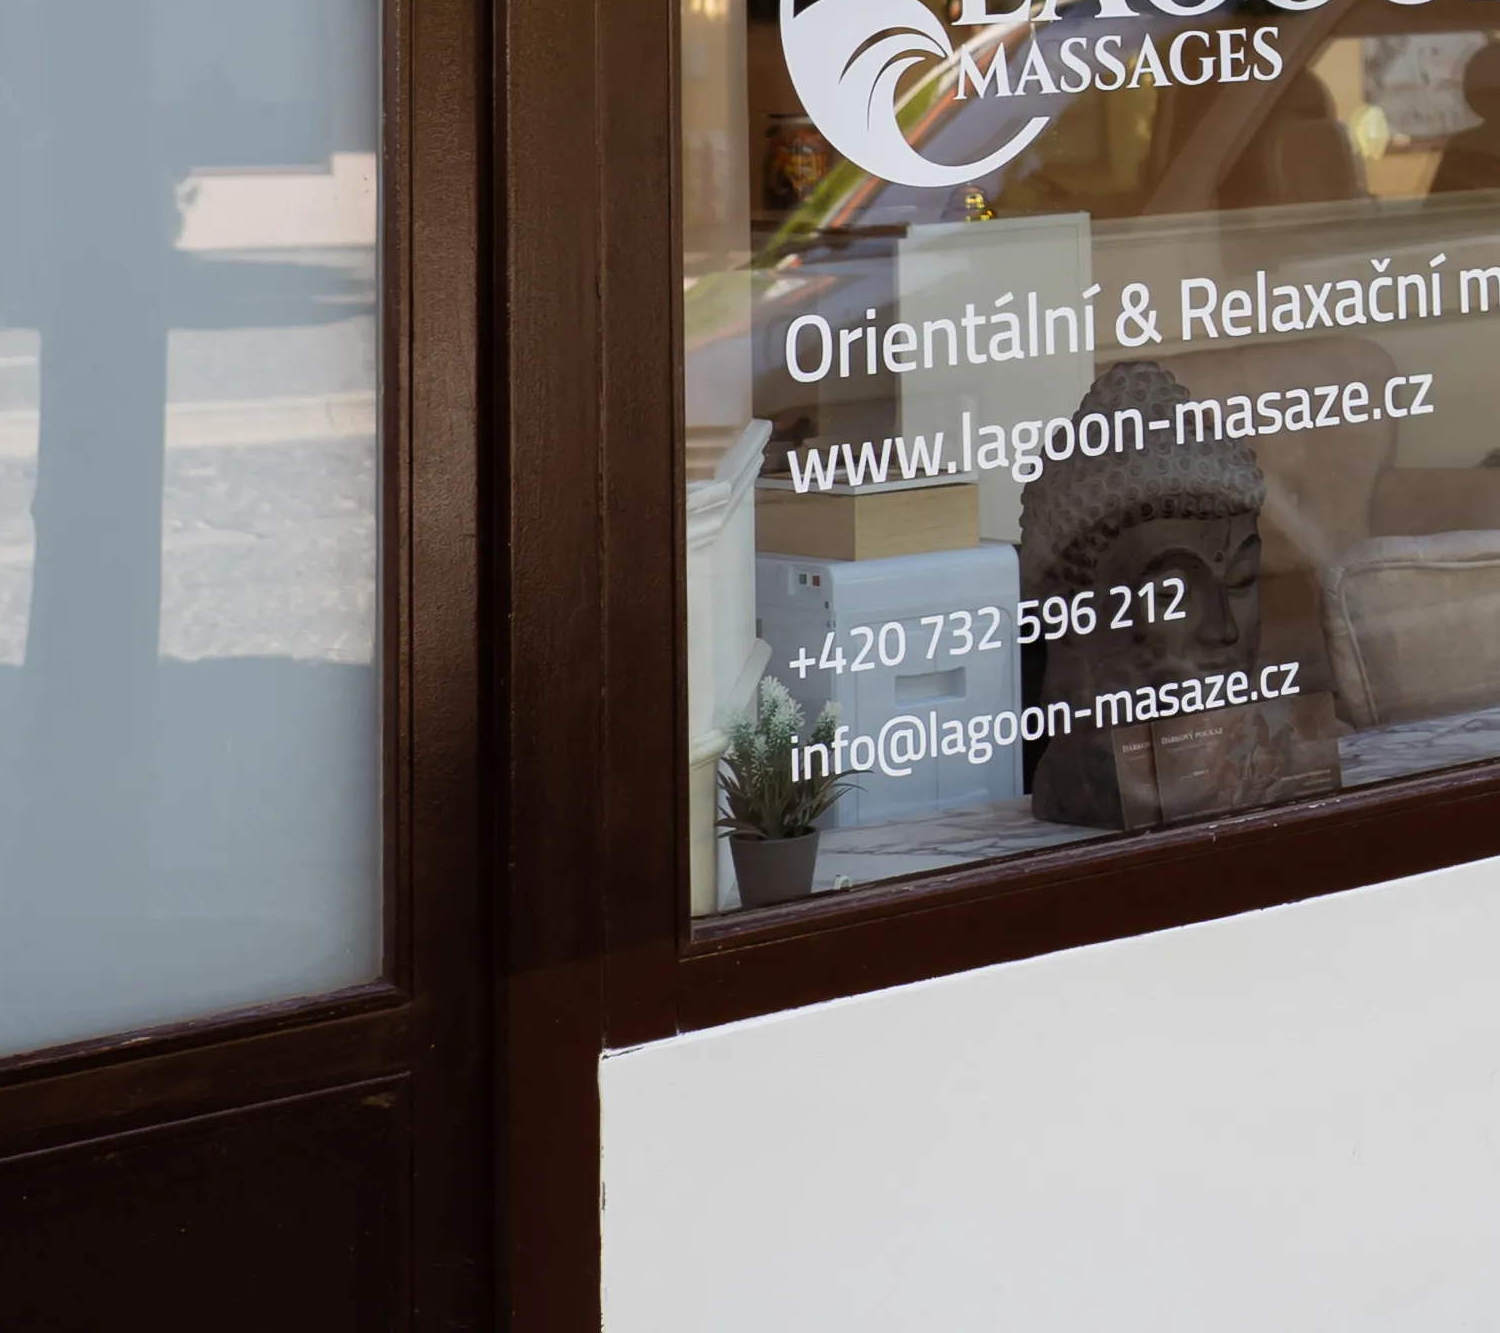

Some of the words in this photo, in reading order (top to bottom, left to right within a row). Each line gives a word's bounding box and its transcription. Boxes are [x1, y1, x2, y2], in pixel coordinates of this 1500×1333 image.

[953, 26, 1284, 102] MASSAGES
[785, 283, 1101, 383] Orientální
[1115, 282, 1162, 347] &
[1180, 253, 1446, 341] Relaxační
[787, 372, 1434, 494] www.lagoon-masaze.cz
[788, 621, 906, 680] +420
[920, 606, 1002, 660] 732
[1016, 591, 1097, 645] 596
[1109, 578, 1187, 630] 212
[790, 661, 1300, 782] info@lagoon-masaze.cz
